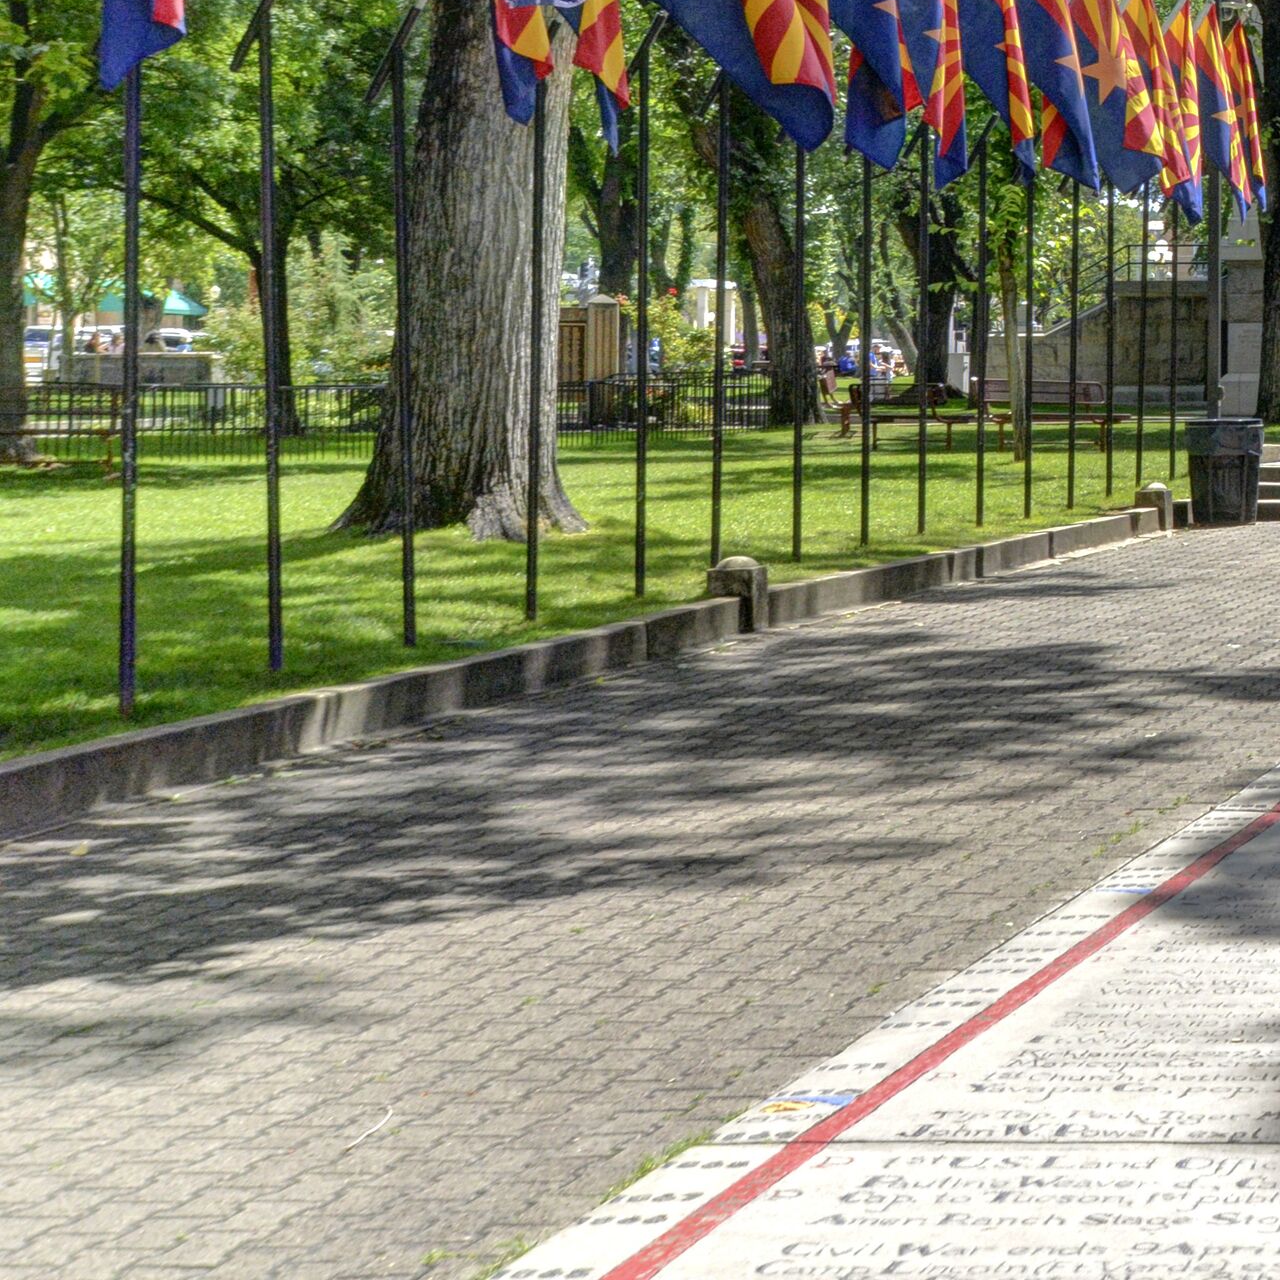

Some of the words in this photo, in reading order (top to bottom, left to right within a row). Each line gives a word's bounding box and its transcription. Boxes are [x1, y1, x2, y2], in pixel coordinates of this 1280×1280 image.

[1000, 1058, 1160, 1073] Maricopa
[1175, 1086, 1260, 1100] pop.
[1157, 1109, 1246, 1126] Tiger
[896, 1122, 995, 1138] John
[1003, 1123, 1047, 1138] W.
[1051, 1122, 1177, 1138] Powell
[881, 1154, 948, 1170] 1st
[1035, 1156, 1158, 1170] Land
[1017, 1175, 1145, 1189] Weaver
[933, 1192, 973, 1205] to
[983, 1190, 1133, 1207] Tucson,
[934, 1211, 1068, 1227] Ranch
[1078, 1211, 1198, 1233] Stage
[780, 1240, 886, 1257] Civil
[898, 1241, 988, 1258] War
[1004, 1240, 1108, 1257] ends
[752, 1258, 873, 1275] Camp
[877, 1259, 1030, 1275] Lincoln
